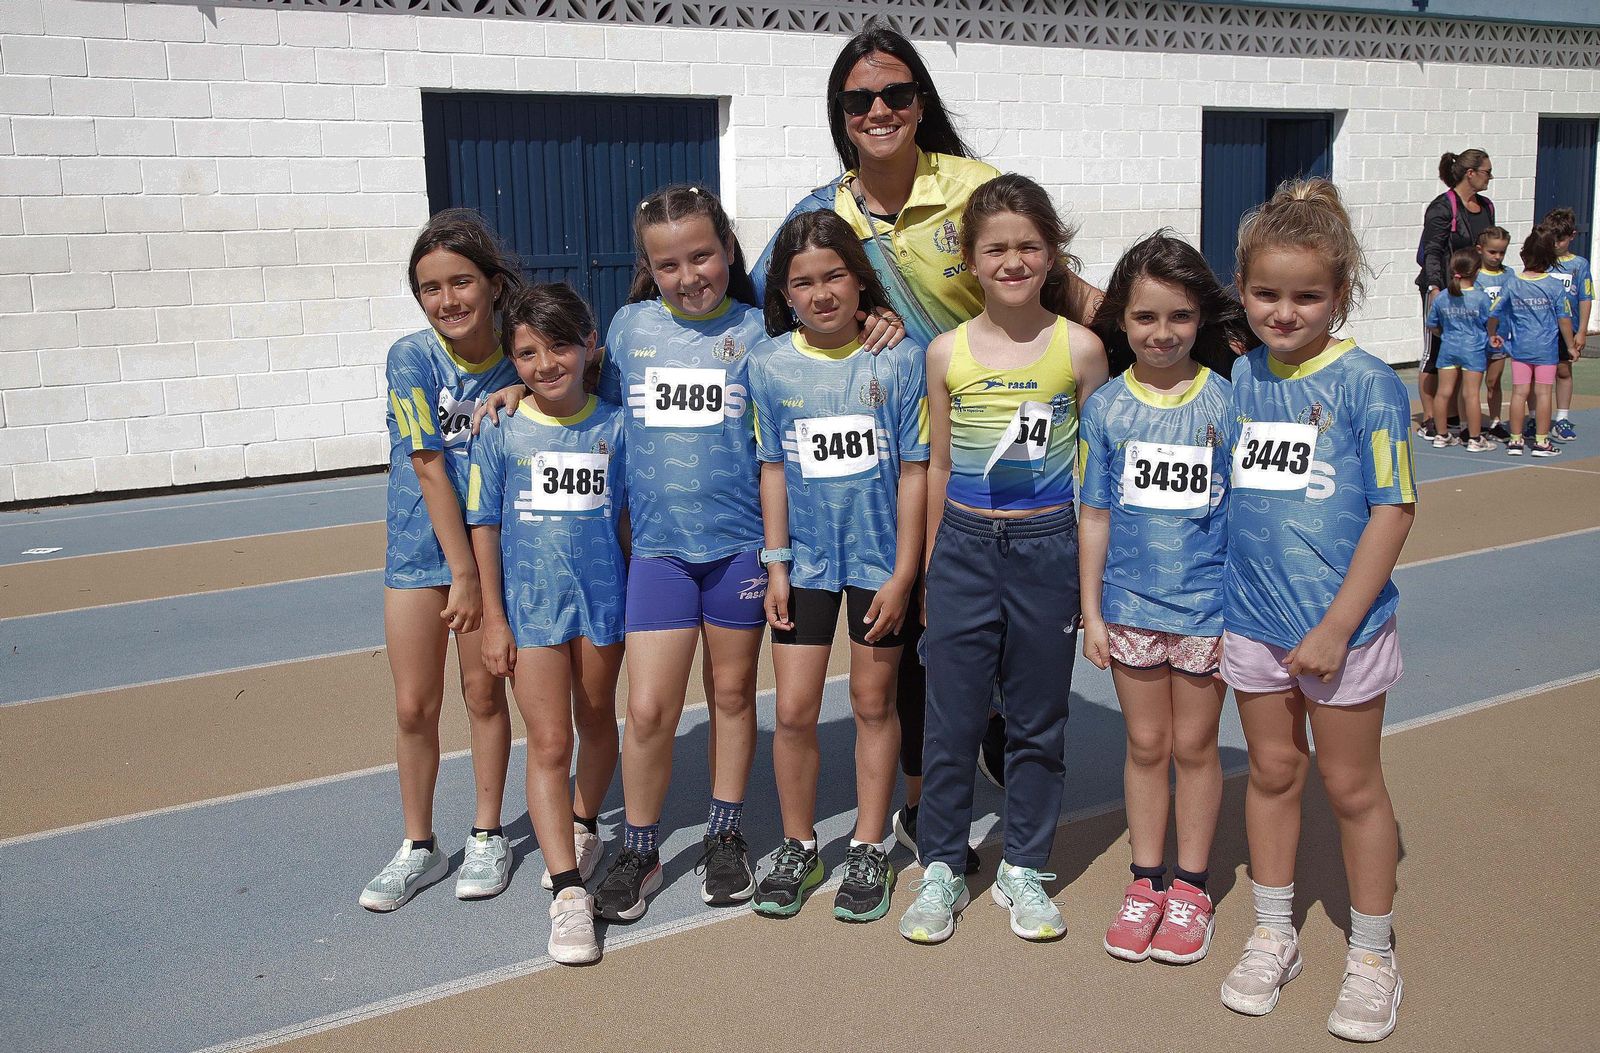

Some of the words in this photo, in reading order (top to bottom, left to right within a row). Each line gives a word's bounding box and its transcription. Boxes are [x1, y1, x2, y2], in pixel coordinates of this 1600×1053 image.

[634, 348, 657, 358] vive
[656, 383, 723, 412] 3489
[1008, 380, 1038, 389] rasán
[812, 429, 875, 461] 3481
[1241, 439, 1311, 474] 3443
[543, 467, 605, 495] 3485
[1134, 459, 1208, 493] 3438
